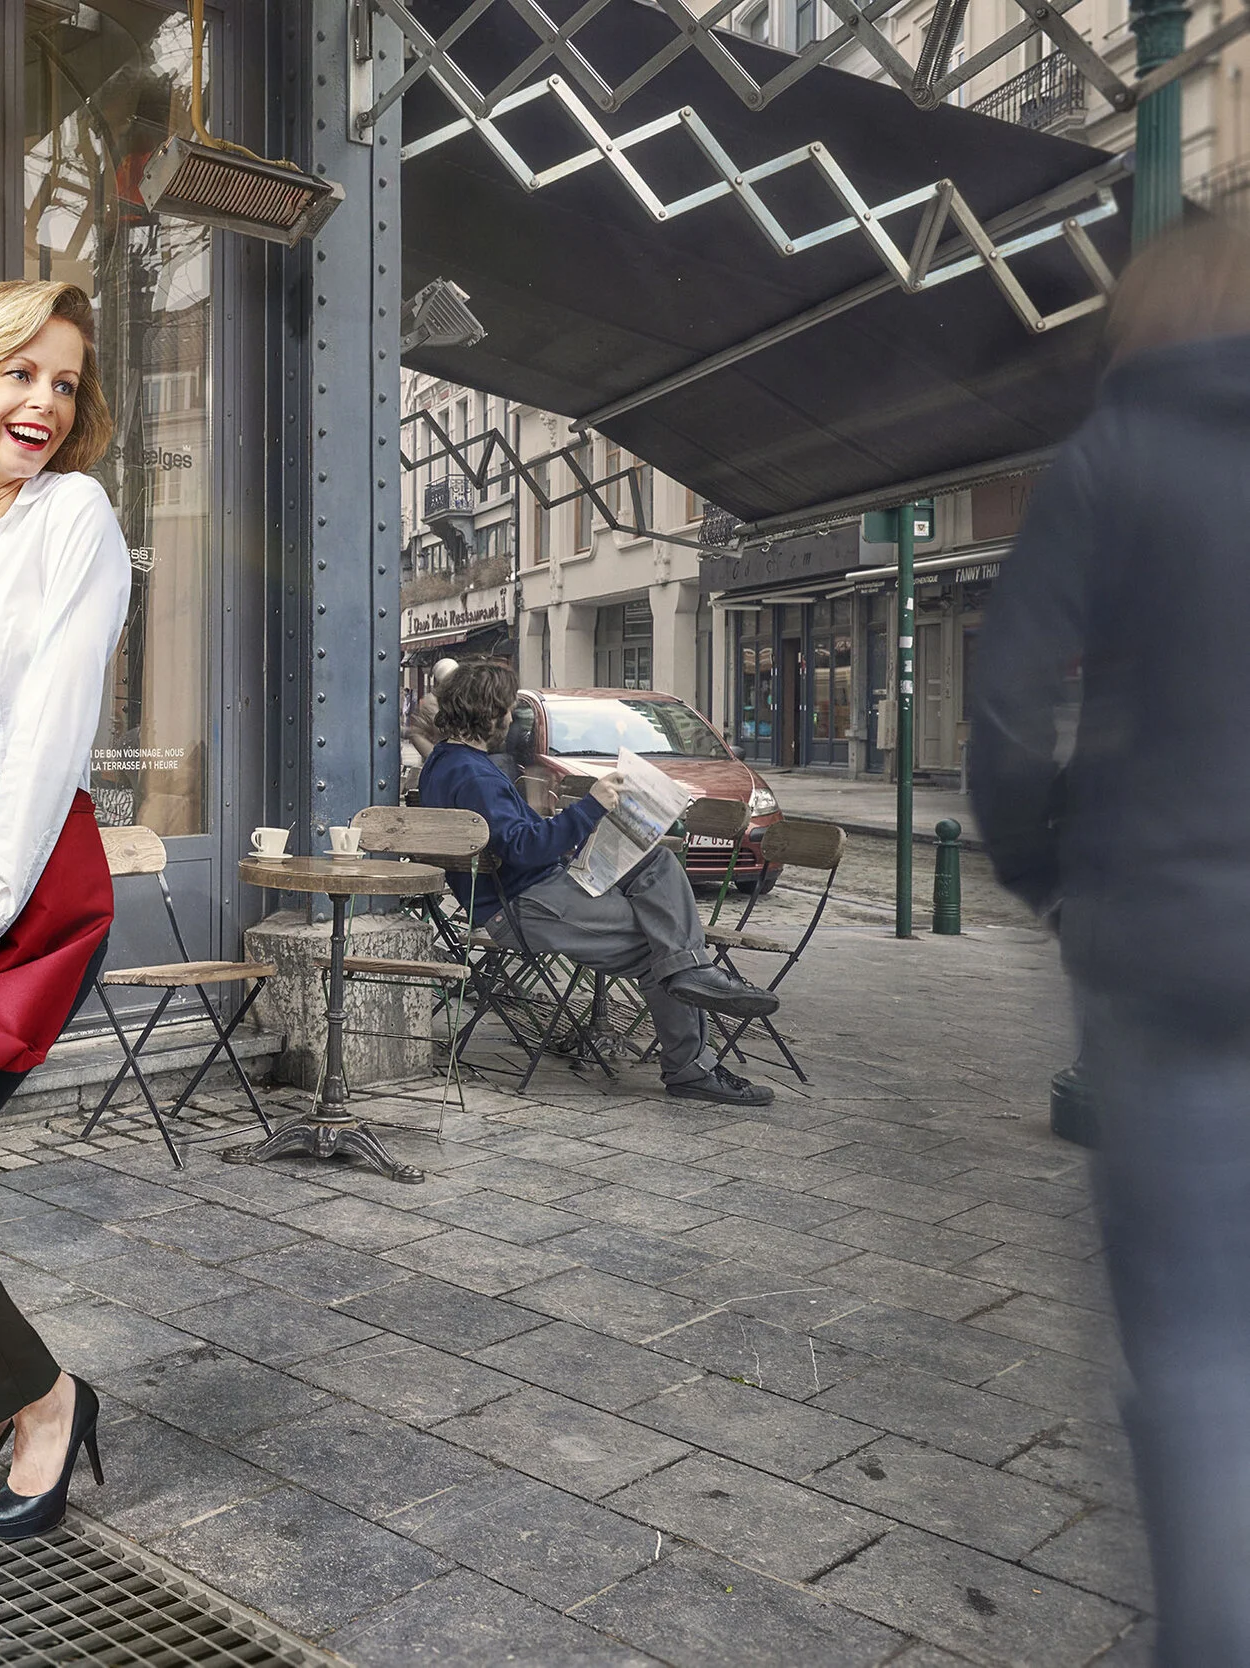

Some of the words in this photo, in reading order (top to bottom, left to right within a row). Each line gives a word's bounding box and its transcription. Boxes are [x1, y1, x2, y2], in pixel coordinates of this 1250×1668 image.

[955, 565, 980, 583] FANNY
[449, 600, 500, 627] Restaurant
[94, 749, 105, 759] DE
[106, 749, 122, 759] BON
[164, 748, 185, 758] NOUS
[91, 762, 101, 771] LA
[102, 761, 141, 771] TERRASSE
[148, 760, 153, 770] 1
[154, 760, 179, 770] HEURE
